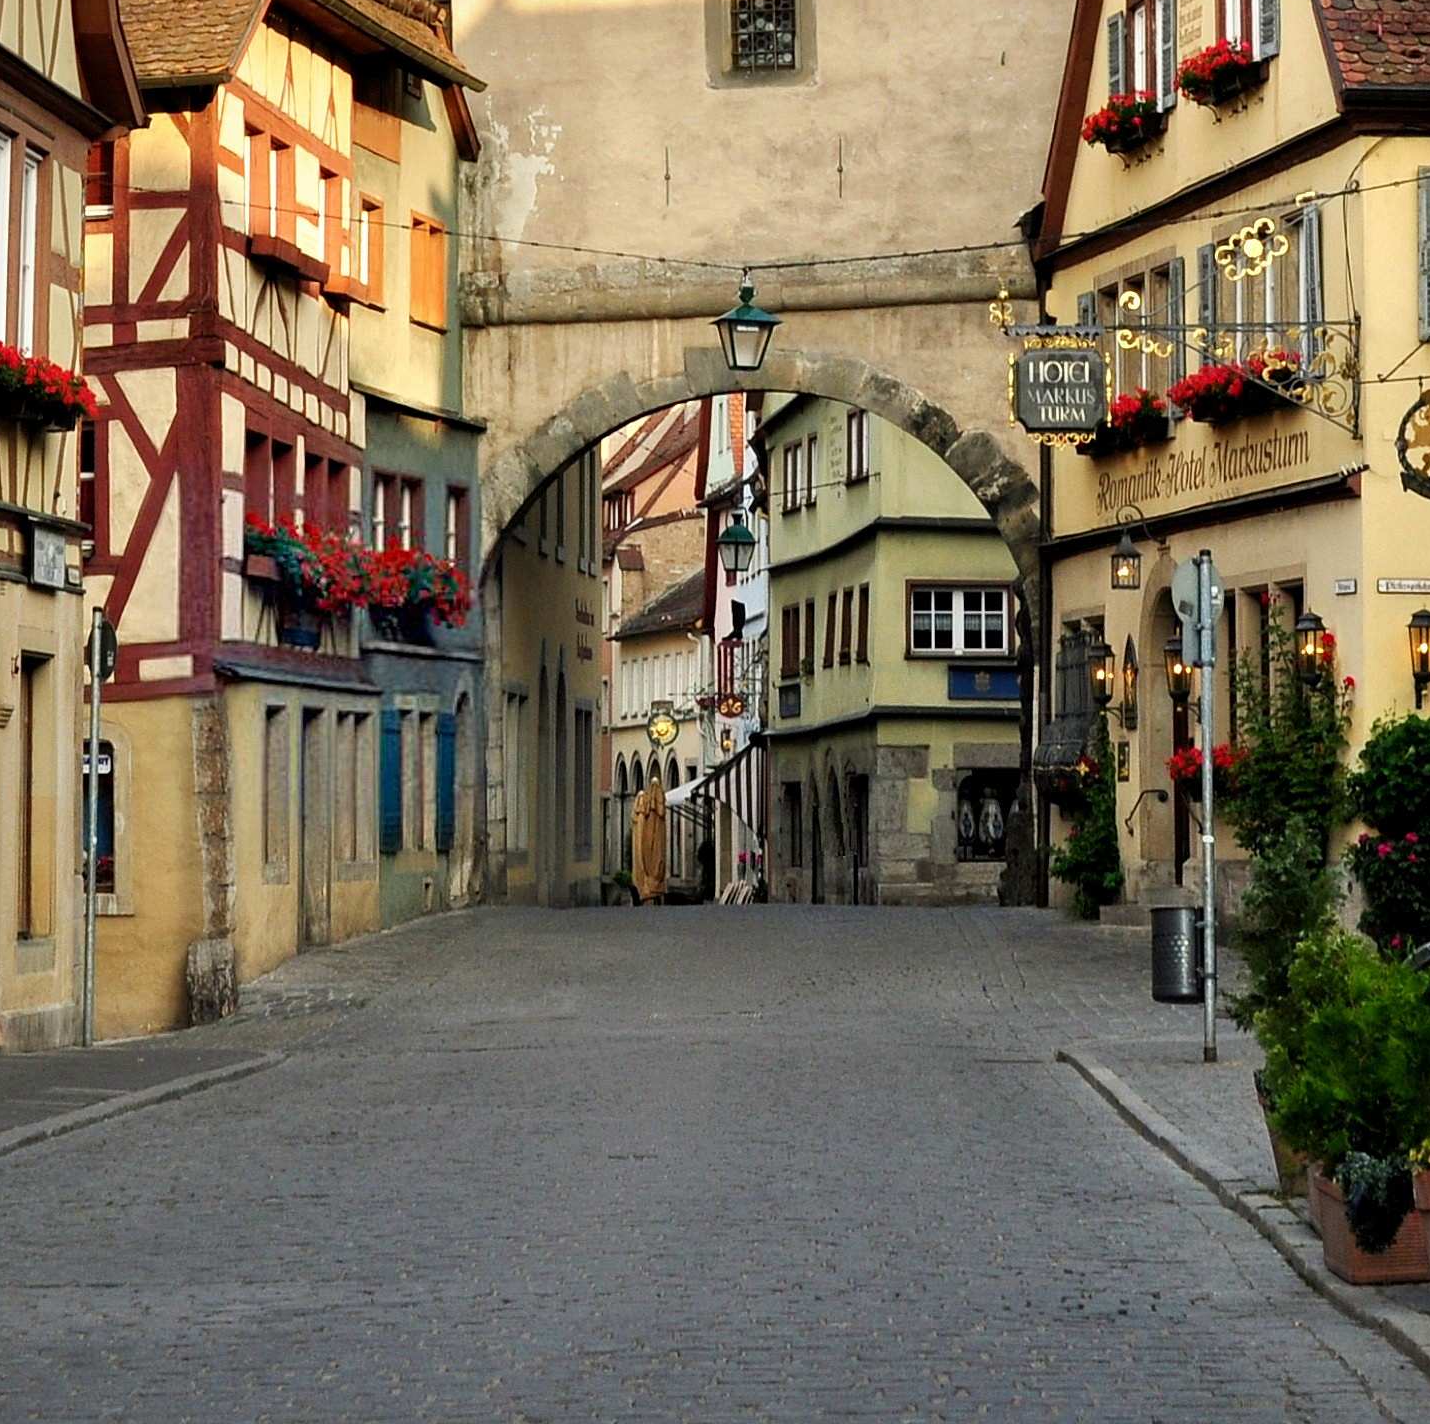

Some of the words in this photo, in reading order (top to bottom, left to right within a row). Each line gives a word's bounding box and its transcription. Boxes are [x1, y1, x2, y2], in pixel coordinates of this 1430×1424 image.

[1028, 360, 1090, 384] HOTEL
[1027, 387, 1096, 405] MARKUS
[1037, 406, 1086, 423] TURM
[1209, 428, 1310, 489] Markusturm
